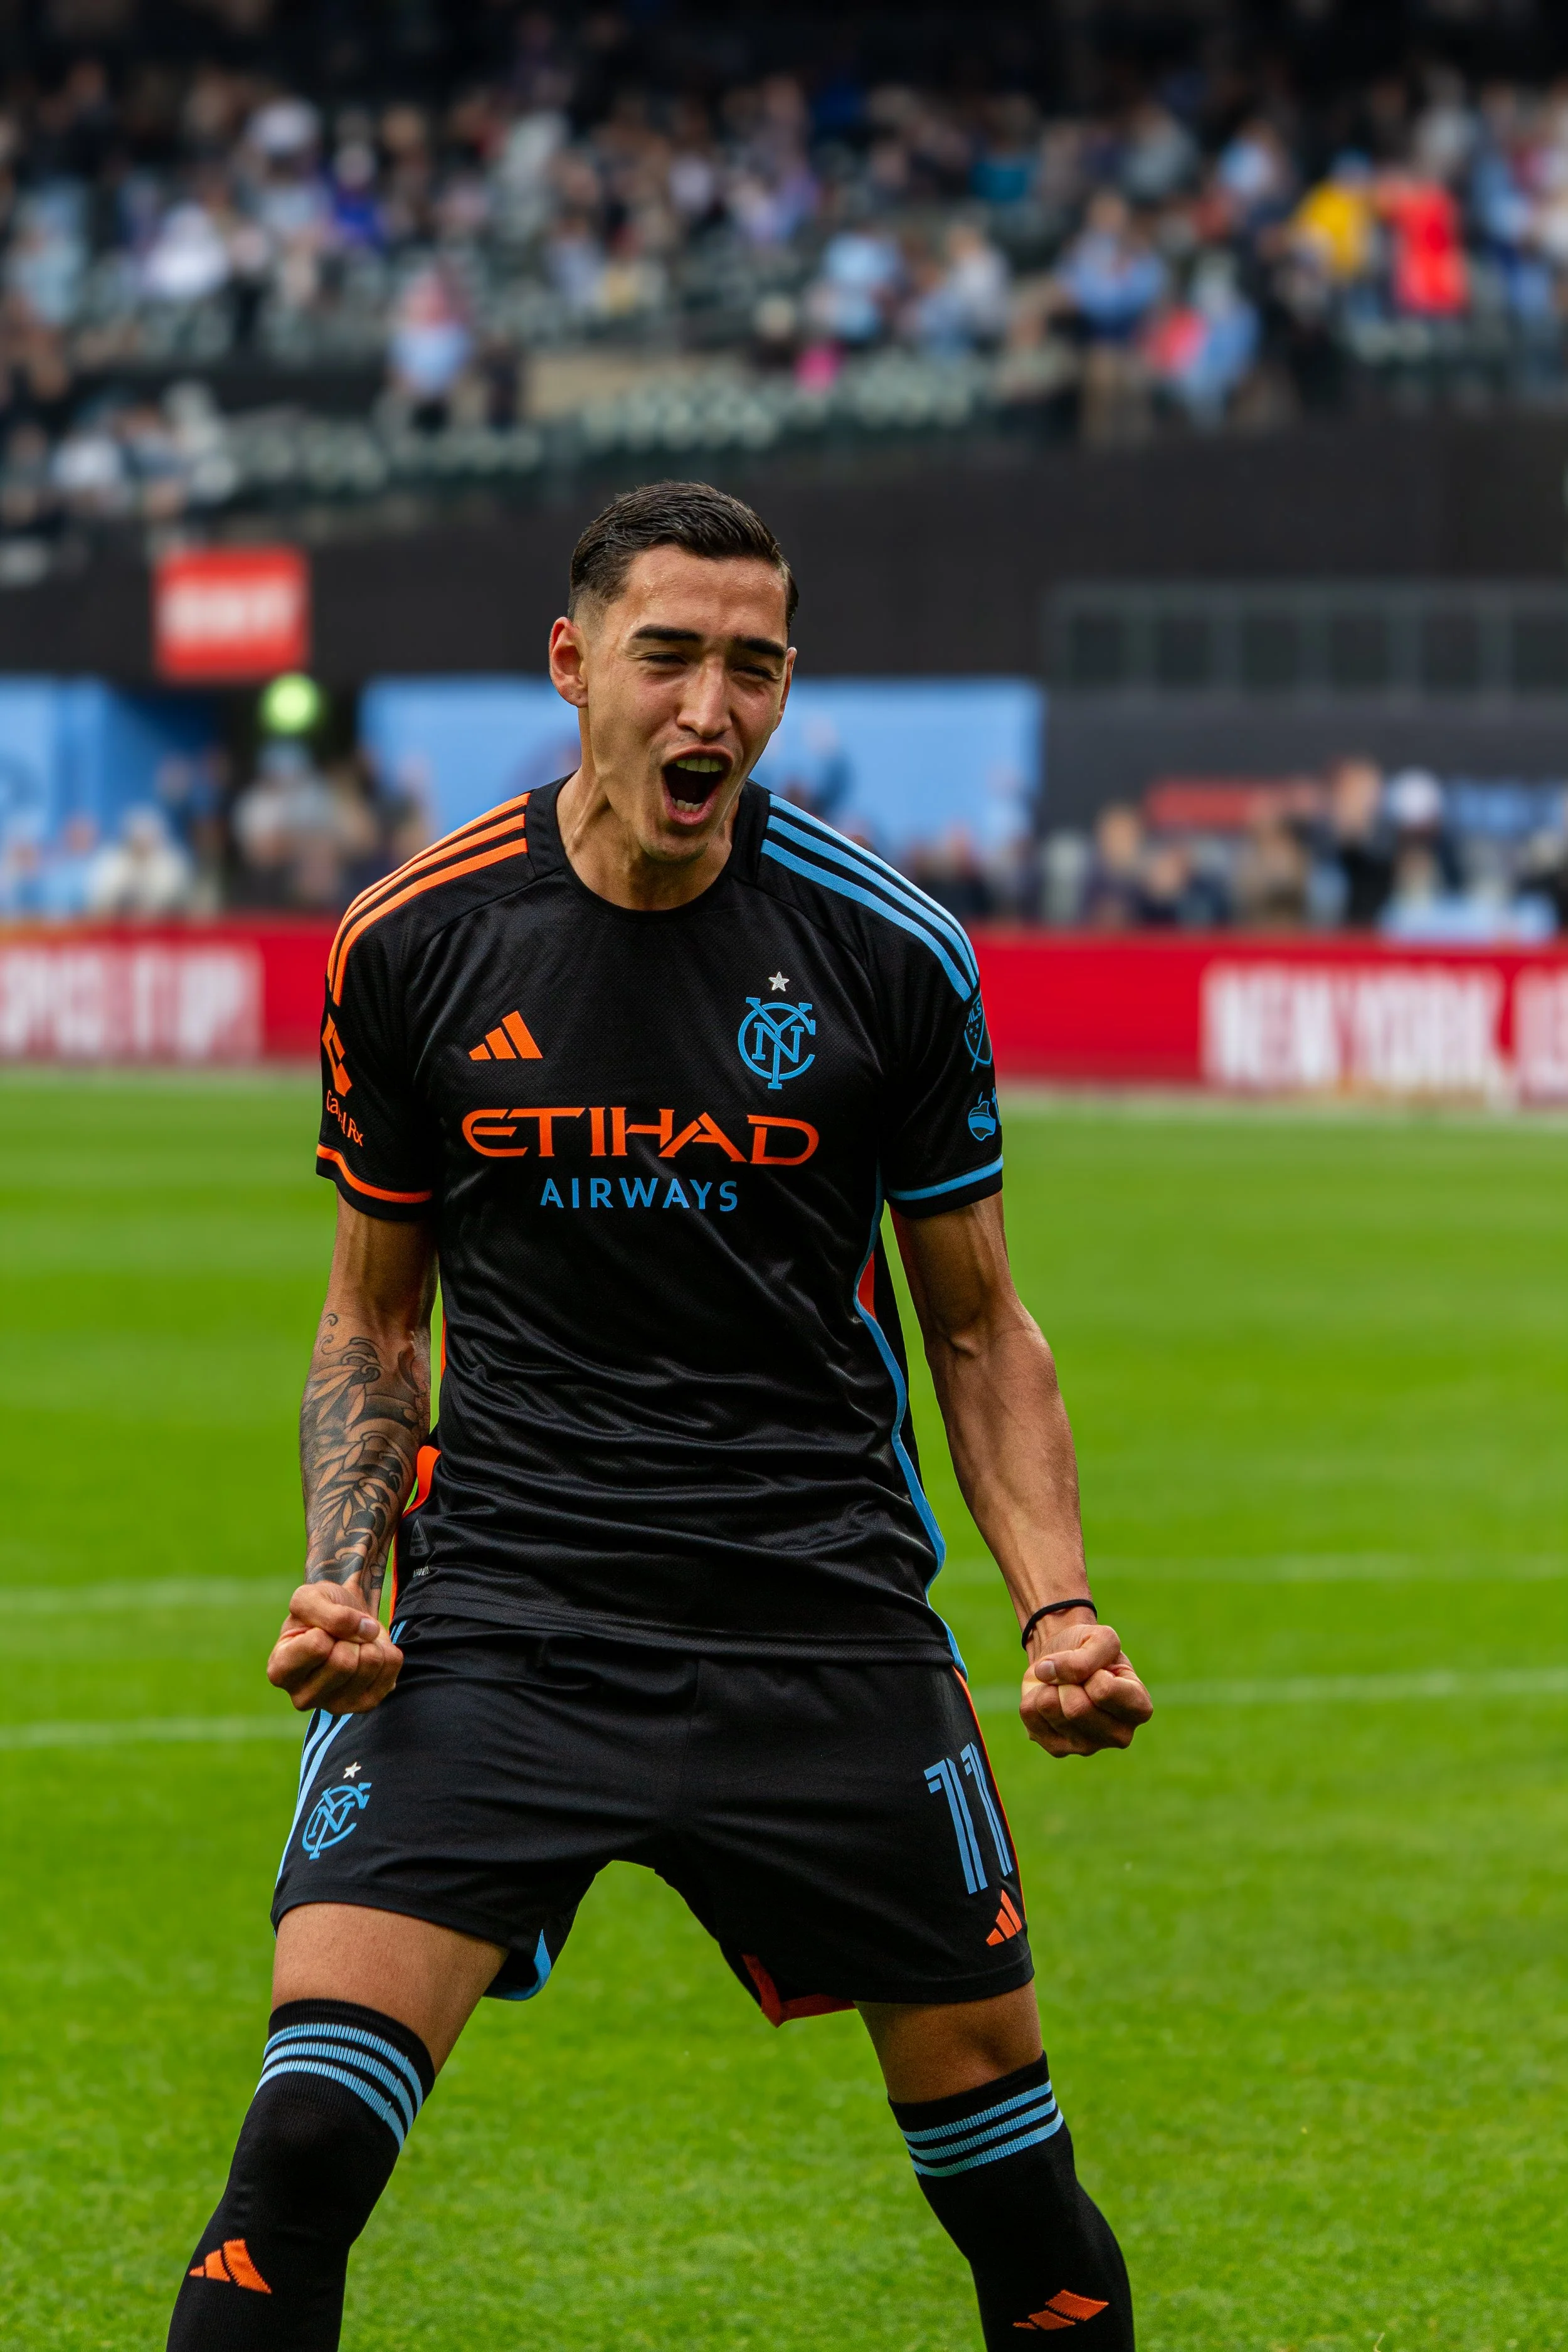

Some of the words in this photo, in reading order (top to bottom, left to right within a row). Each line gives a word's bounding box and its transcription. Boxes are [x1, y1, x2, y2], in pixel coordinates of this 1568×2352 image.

[462, 1106, 819, 1166] ETIHAD
[540, 1177, 738, 1212] AIRWAYS
[924, 1742, 1013, 1895] 11
